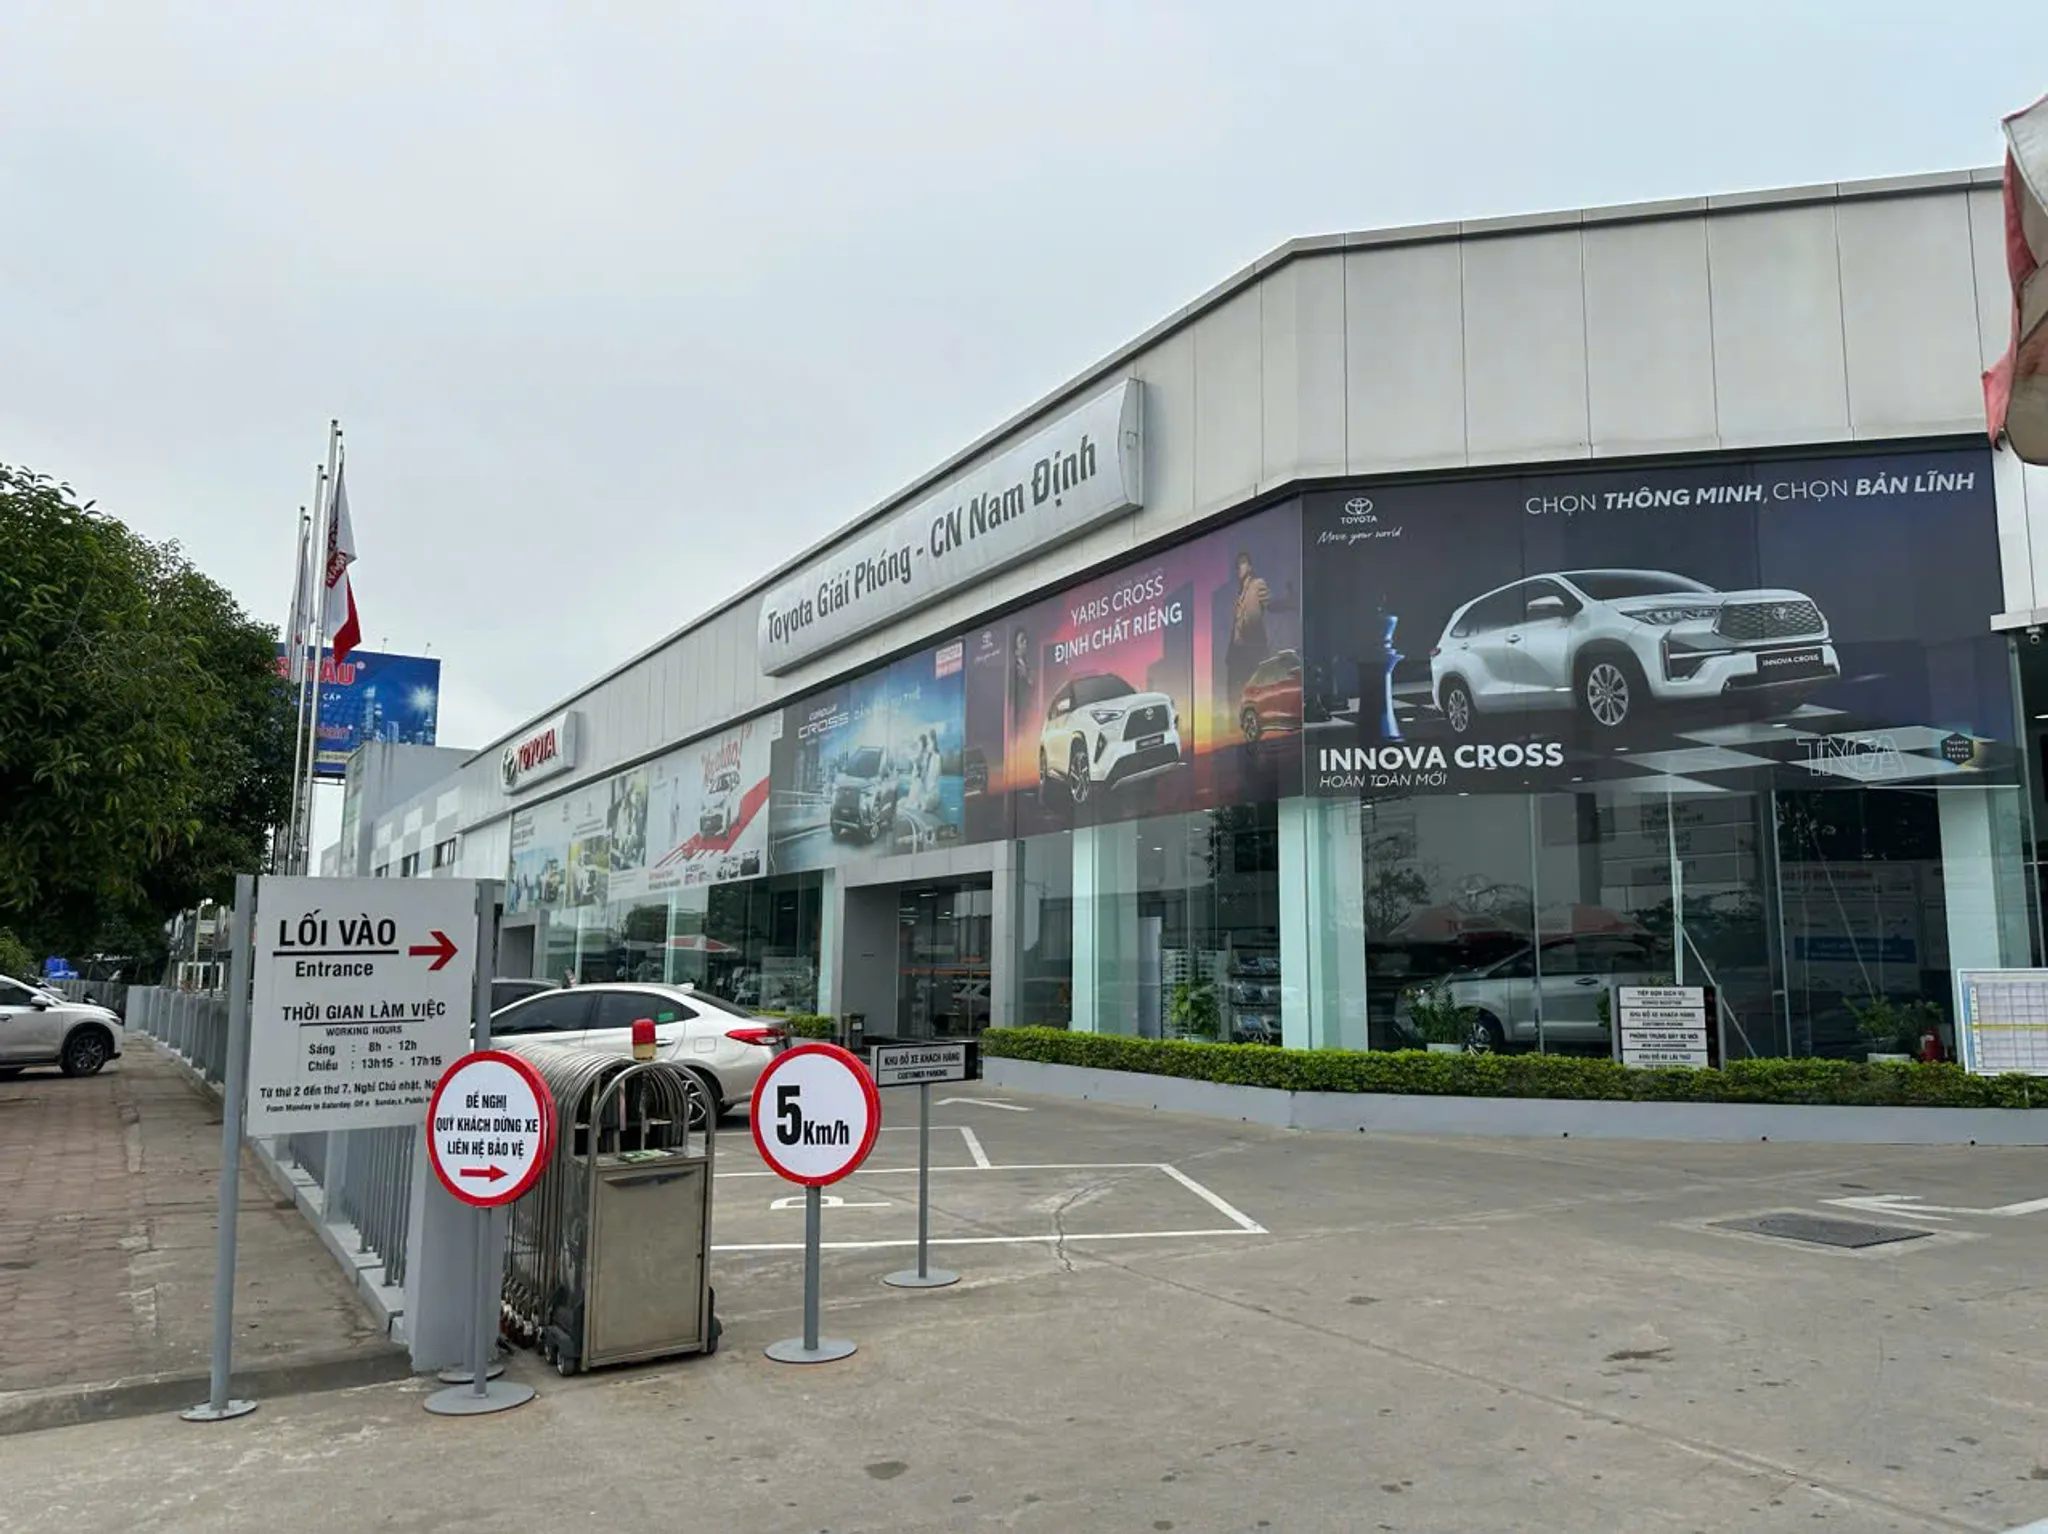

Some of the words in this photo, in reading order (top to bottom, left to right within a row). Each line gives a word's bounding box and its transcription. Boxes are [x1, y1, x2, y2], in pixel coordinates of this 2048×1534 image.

[1526, 494, 1597, 516] CHỌN
[1603, 487, 1690, 509] THÔNG
[1696, 485, 1768, 504] MINH,
[1773, 479, 1848, 502] CHỌN
[1855, 472, 1909, 496] BẢN
[1914, 470, 1975, 494] LĨNH
[1341, 515, 1378, 524] TOYOTA
[768, 600, 813, 643] Toyota
[855, 546, 911, 599] Phóng
[916, 547, 924, 555] -
[931, 506, 962, 558] CN
[969, 484, 1025, 539] Nam
[1031, 435, 1096, 507] Định
[1348, 531, 1373, 546] your
[1376, 526, 1402, 538] world
[1071, 597, 1109, 628] YARIS
[1112, 576, 1164, 612] CROSS
[1055, 636, 1088, 664] ĐỊNH
[1092, 616, 1130, 650] CHẤT
[1133, 602, 1182, 637] RIÊNG
[517, 728, 556, 773] TOYOTA
[1319, 746, 1447, 771] INNOVA
[1454, 743, 1564, 769] CROSS
[1370, 772, 1411, 787] TOÀN
[1415, 770, 1448, 786] MỚI
[279, 909, 328, 947] LỐI
[338, 913, 396, 946] VÀO
[295, 960, 374, 977] Entrance
[282, 1002, 319, 1020] THỜI
[326, 1004, 364, 1019] GIAN
[370, 1001, 404, 1018] LÀM
[411, 999, 446, 1019] VIỆC
[326, 1026, 369, 1036] WORKING
[372, 1025, 402, 1035] HOURS
[308, 1043, 335, 1056] Sáng
[368, 1041, 381, 1052] 8h
[399, 1040, 417, 1051] 12h
[362, 1058, 394, 1069] 13h15
[410, 1056, 442, 1066] 17h15
[884, 1056, 898, 1066] KHU
[911, 1054, 919, 1063] XE
[294, 1086, 301, 1096] 2
[481, 1094, 507, 1112] NGHỊ
[435, 1114, 454, 1132] QUÝ
[457, 1115, 490, 1131] KHÁCH
[524, 1119, 538, 1132] XE
[776, 1085, 802, 1146] 5
[803, 1119, 850, 1146] Km/h
[447, 1138, 469, 1155] LIÊN
[472, 1138, 484, 1159] HỆ
[487, 1137, 508, 1156] BẢO
[511, 1139, 525, 1160] VỆ
